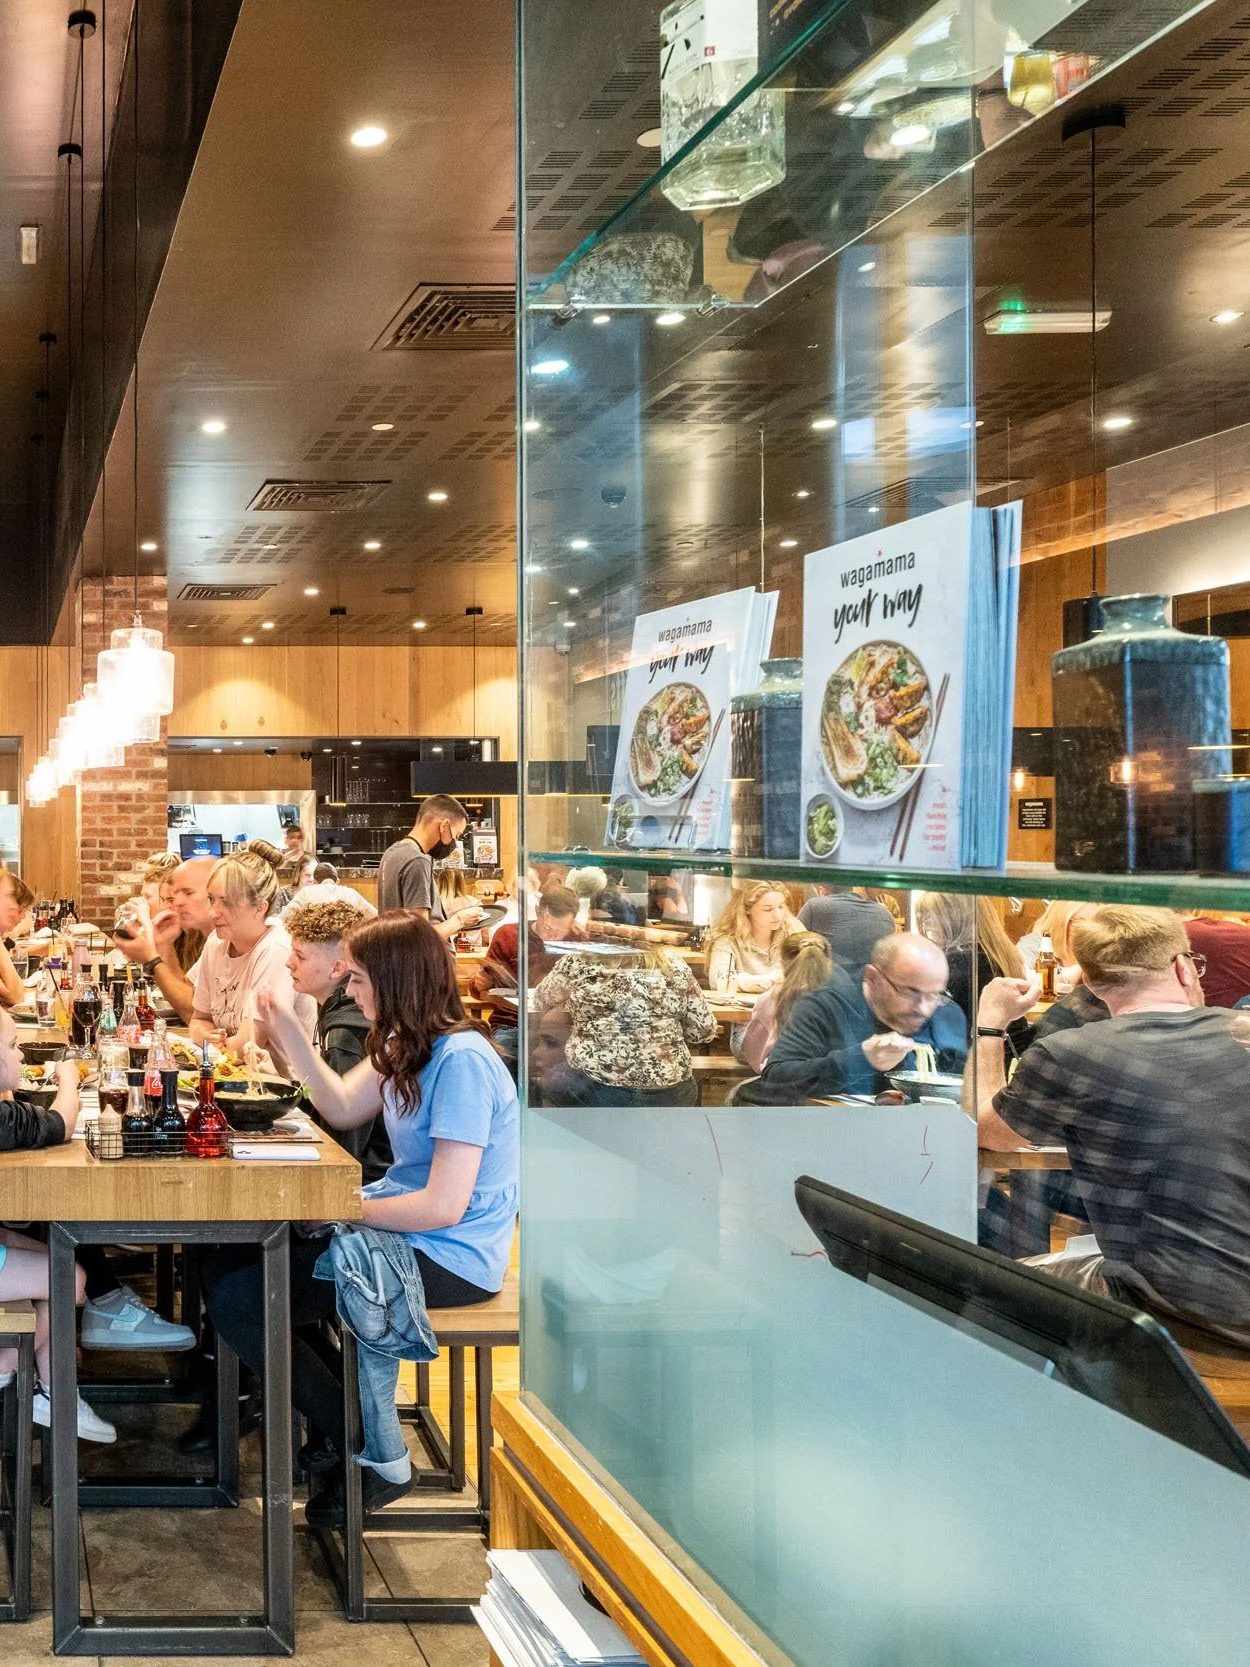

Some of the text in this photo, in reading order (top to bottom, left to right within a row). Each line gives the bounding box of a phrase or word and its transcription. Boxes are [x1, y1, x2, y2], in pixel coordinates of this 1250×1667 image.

[840, 551, 915, 588] wagamama
[834, 583, 923, 644] your way
[658, 619, 712, 643] wagamama
[684, 645, 715, 675] way
